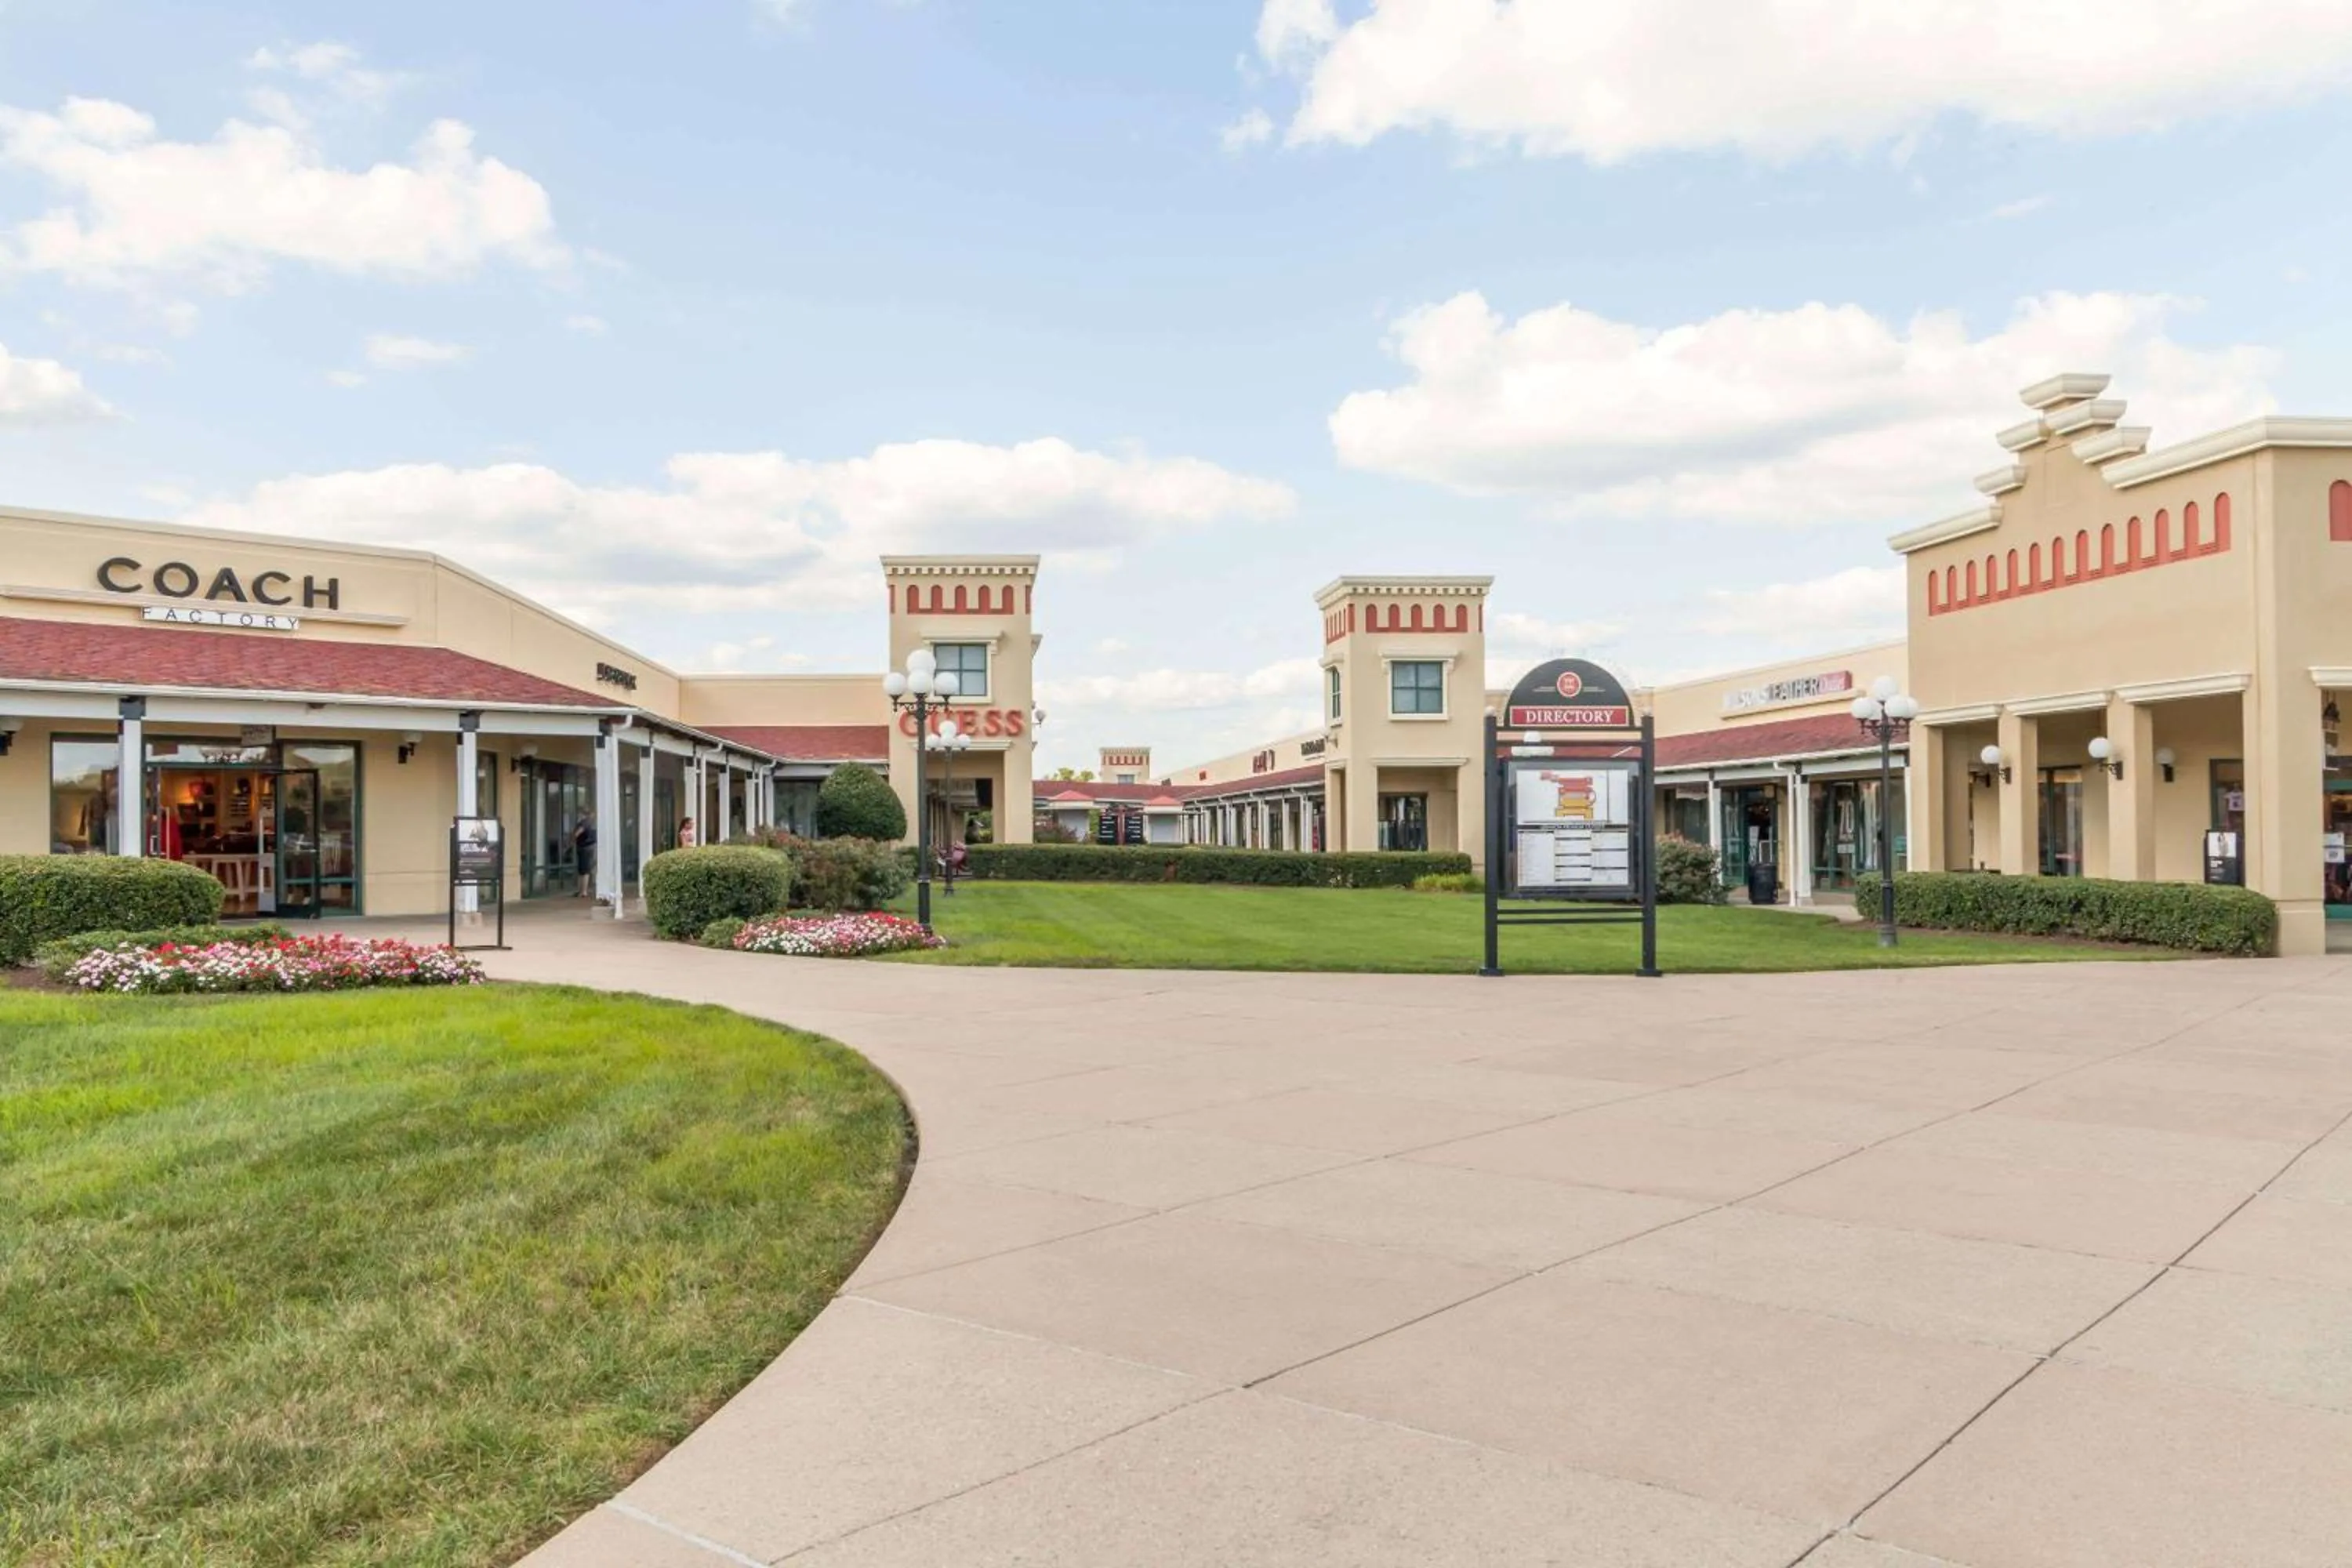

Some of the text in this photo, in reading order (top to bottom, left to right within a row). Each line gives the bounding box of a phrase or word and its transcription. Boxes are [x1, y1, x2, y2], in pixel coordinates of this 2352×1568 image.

[96, 557, 339, 610] COACH
[141, 605, 299, 629] FACTORY
[1526, 710, 1613, 723] DIRECTORY
